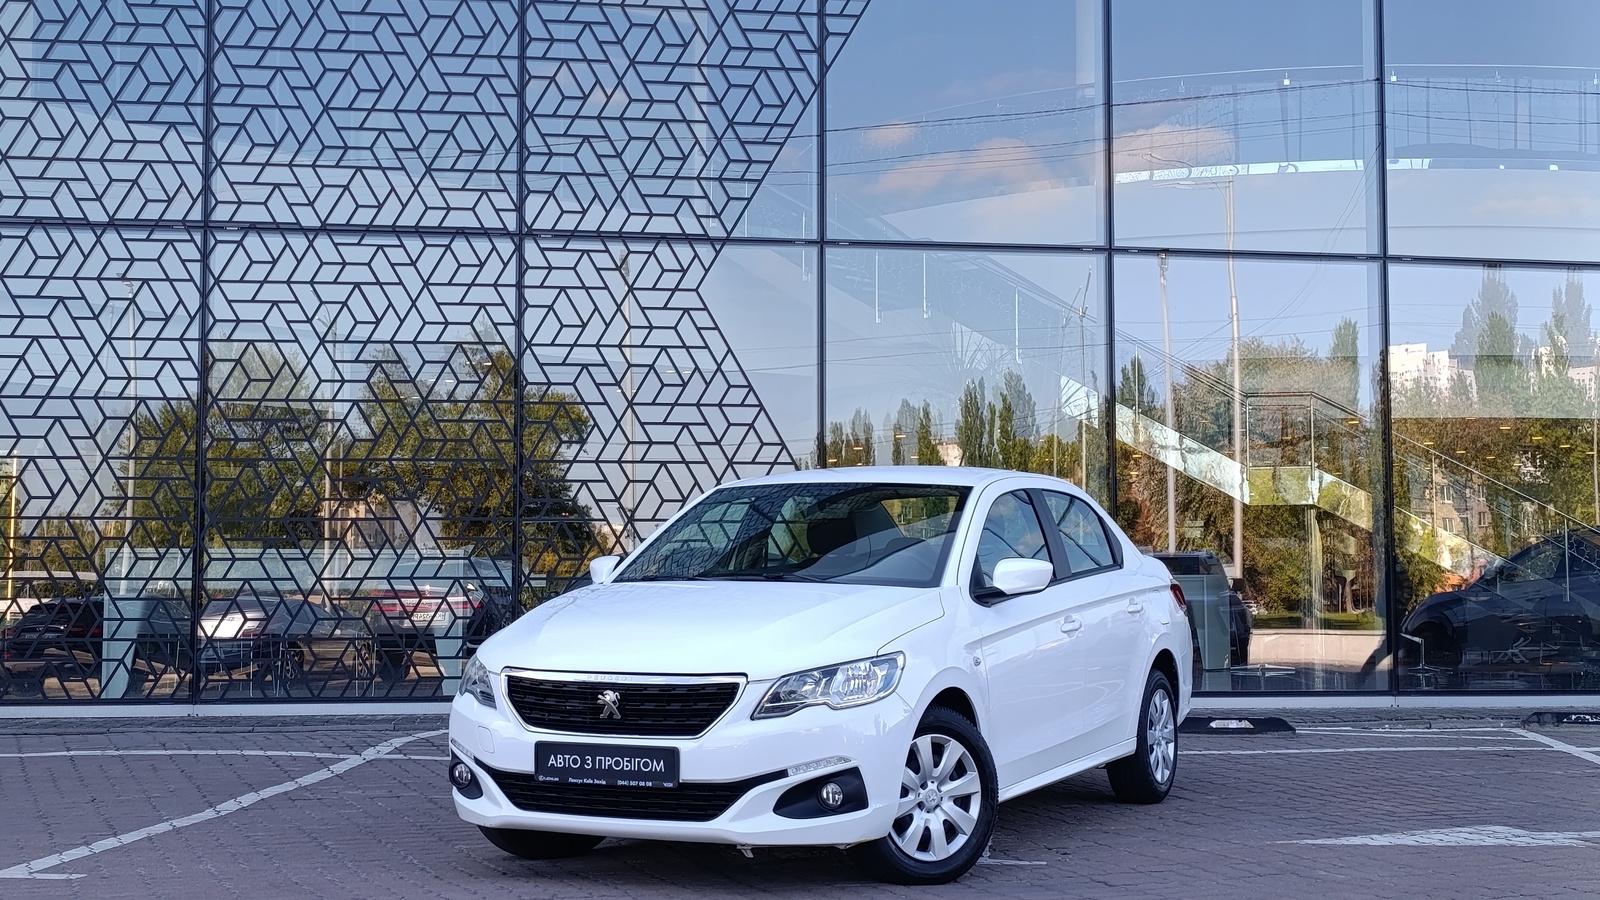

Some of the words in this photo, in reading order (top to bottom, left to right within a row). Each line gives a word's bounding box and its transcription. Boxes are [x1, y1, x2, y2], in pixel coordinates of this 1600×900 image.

[547, 754, 581, 768] АВТО
[584, 756, 593, 769] З
[595, 756, 665, 772] ПРОБІГОМ
